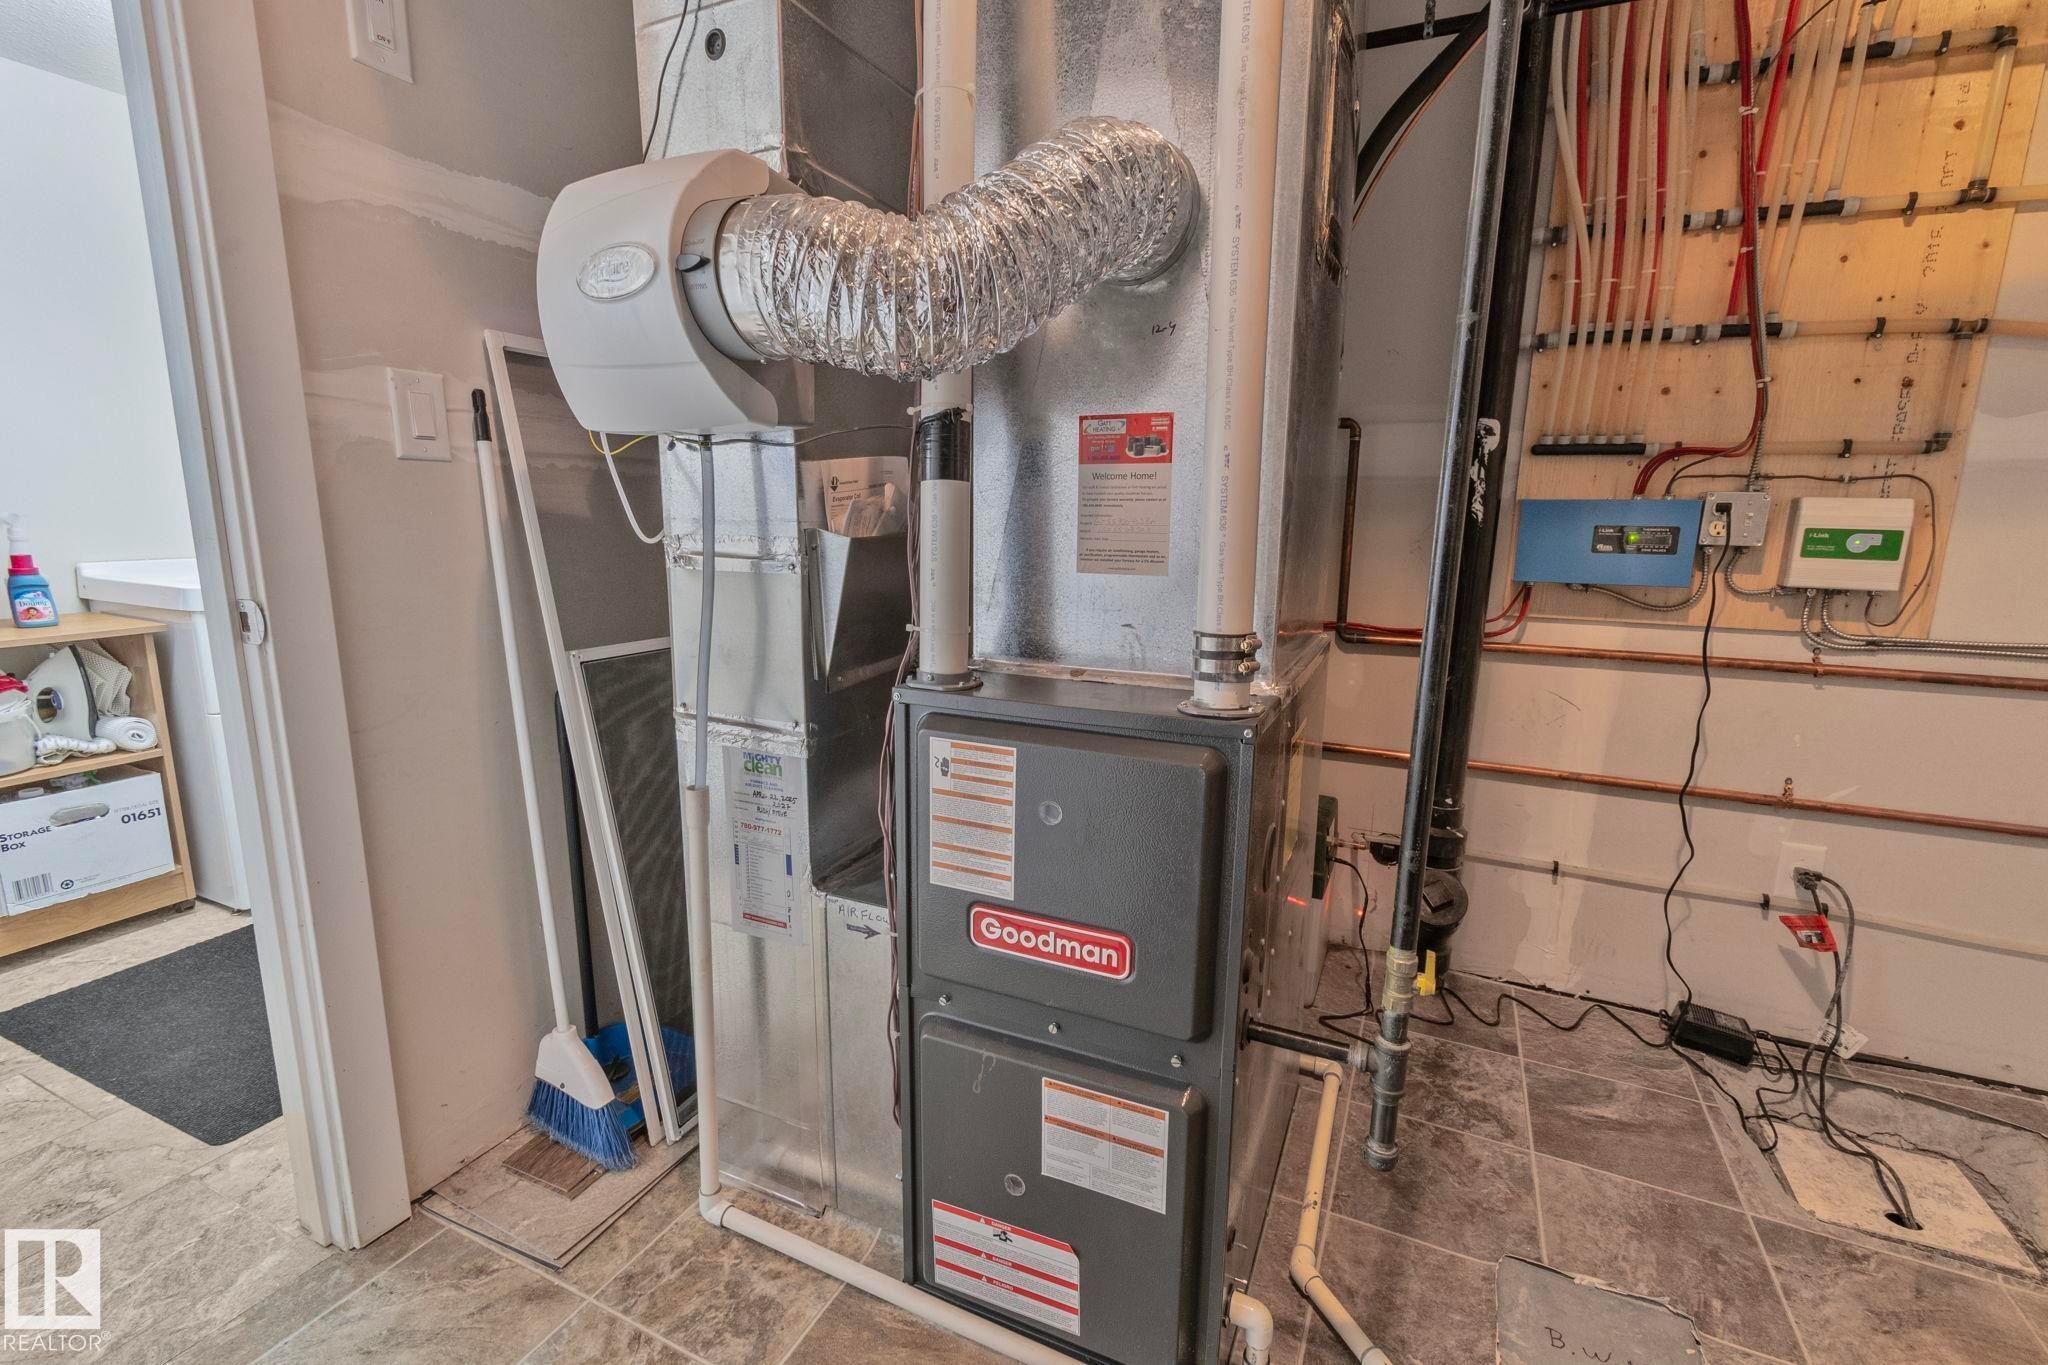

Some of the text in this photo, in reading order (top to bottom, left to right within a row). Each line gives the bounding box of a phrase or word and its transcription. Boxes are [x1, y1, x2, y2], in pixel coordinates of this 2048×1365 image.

[1230, 237, 1240, 278] SYSTEM
[1229, 279, 1238, 296] 636
[1226, 344, 1234, 362] Type
[1225, 378, 1233, 399] Class
[1091, 471, 1157, 481] Welcome Home!
[1220, 475, 1229, 514] SYSTEM
[930, 530, 938, 562] SYSTEM
[743, 756, 783, 777] clean
[120, 807, 161, 824] 01651
[980, 917, 1118, 968] Goodman
[991, 1221, 1012, 1231] DANGER
[992, 1256, 1013, 1267] DANGER
[993, 1279, 1014, 1291] PELIGRO
